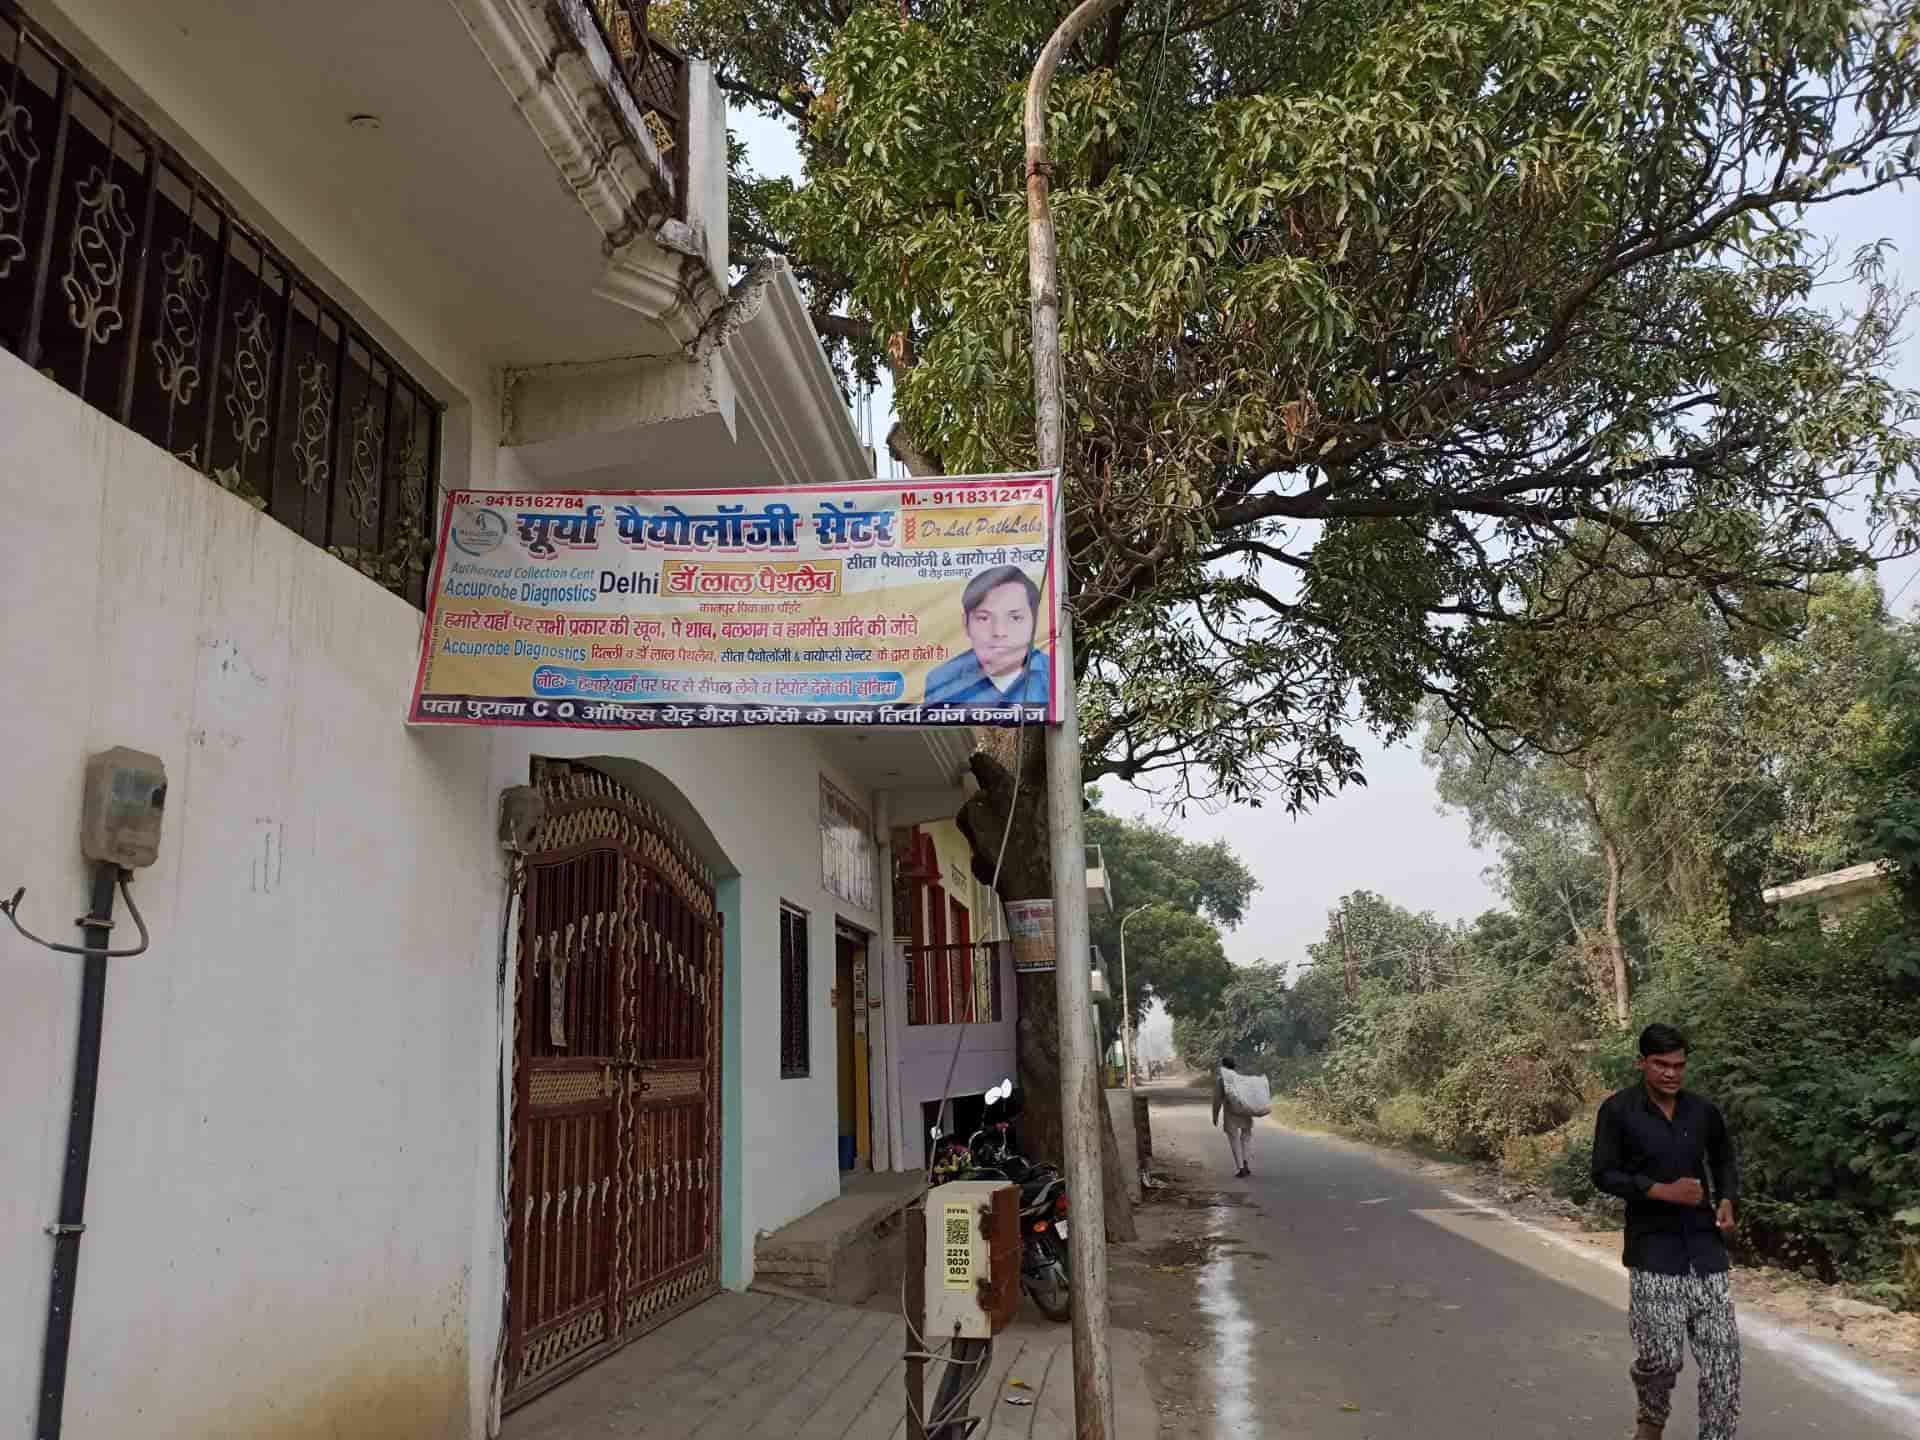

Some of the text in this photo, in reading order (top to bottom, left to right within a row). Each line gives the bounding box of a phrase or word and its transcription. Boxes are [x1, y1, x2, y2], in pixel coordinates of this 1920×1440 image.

[485, 495, 584, 509] 9415162784
[933, 487, 1043, 505] 9118312474
[811, 501, 897, 549] सेंटर
[846, 553, 877, 571] सीता
[881, 550, 938, 570] पैथोलॉजी
[941, 553, 952, 566] &
[514, 566, 568, 581] Collection
[600, 570, 659, 595] Delhi
[700, 571, 753, 593] लाल
[758, 565, 834, 593] पैथलैब
[445, 579, 597, 606] Accuprobe Diagnostics
[443, 611, 481, 630] हमारे
[513, 616, 531, 632] पर
[536, 614, 566, 636] सभी
[569, 616, 606, 637] प्रकार
[608, 615, 629, 636] की
[722, 621, 769, 638] बलगम
[831, 615, 867, 637] आदि
[867, 614, 887, 636] की
[443, 639, 510, 657] Accuprobe
[514, 639, 587, 662] Diagnostics
[591, 643, 623, 660] दिल्ली
[650, 648, 674, 661] लाल
[720, 648, 745, 663] सीता
[639, 679, 657, 693] पर
[422, 699, 462, 715] पता
[467, 699, 527, 720] पुराना
[532, 700, 550, 717] C
[557, 701, 575, 718] O
[699, 704, 739, 723] गैस
[743, 705, 802, 724] एजेंसी
[806, 707, 826, 724] के
[834, 708, 875, 724] पास
[928, 705, 967, 723] गंज
